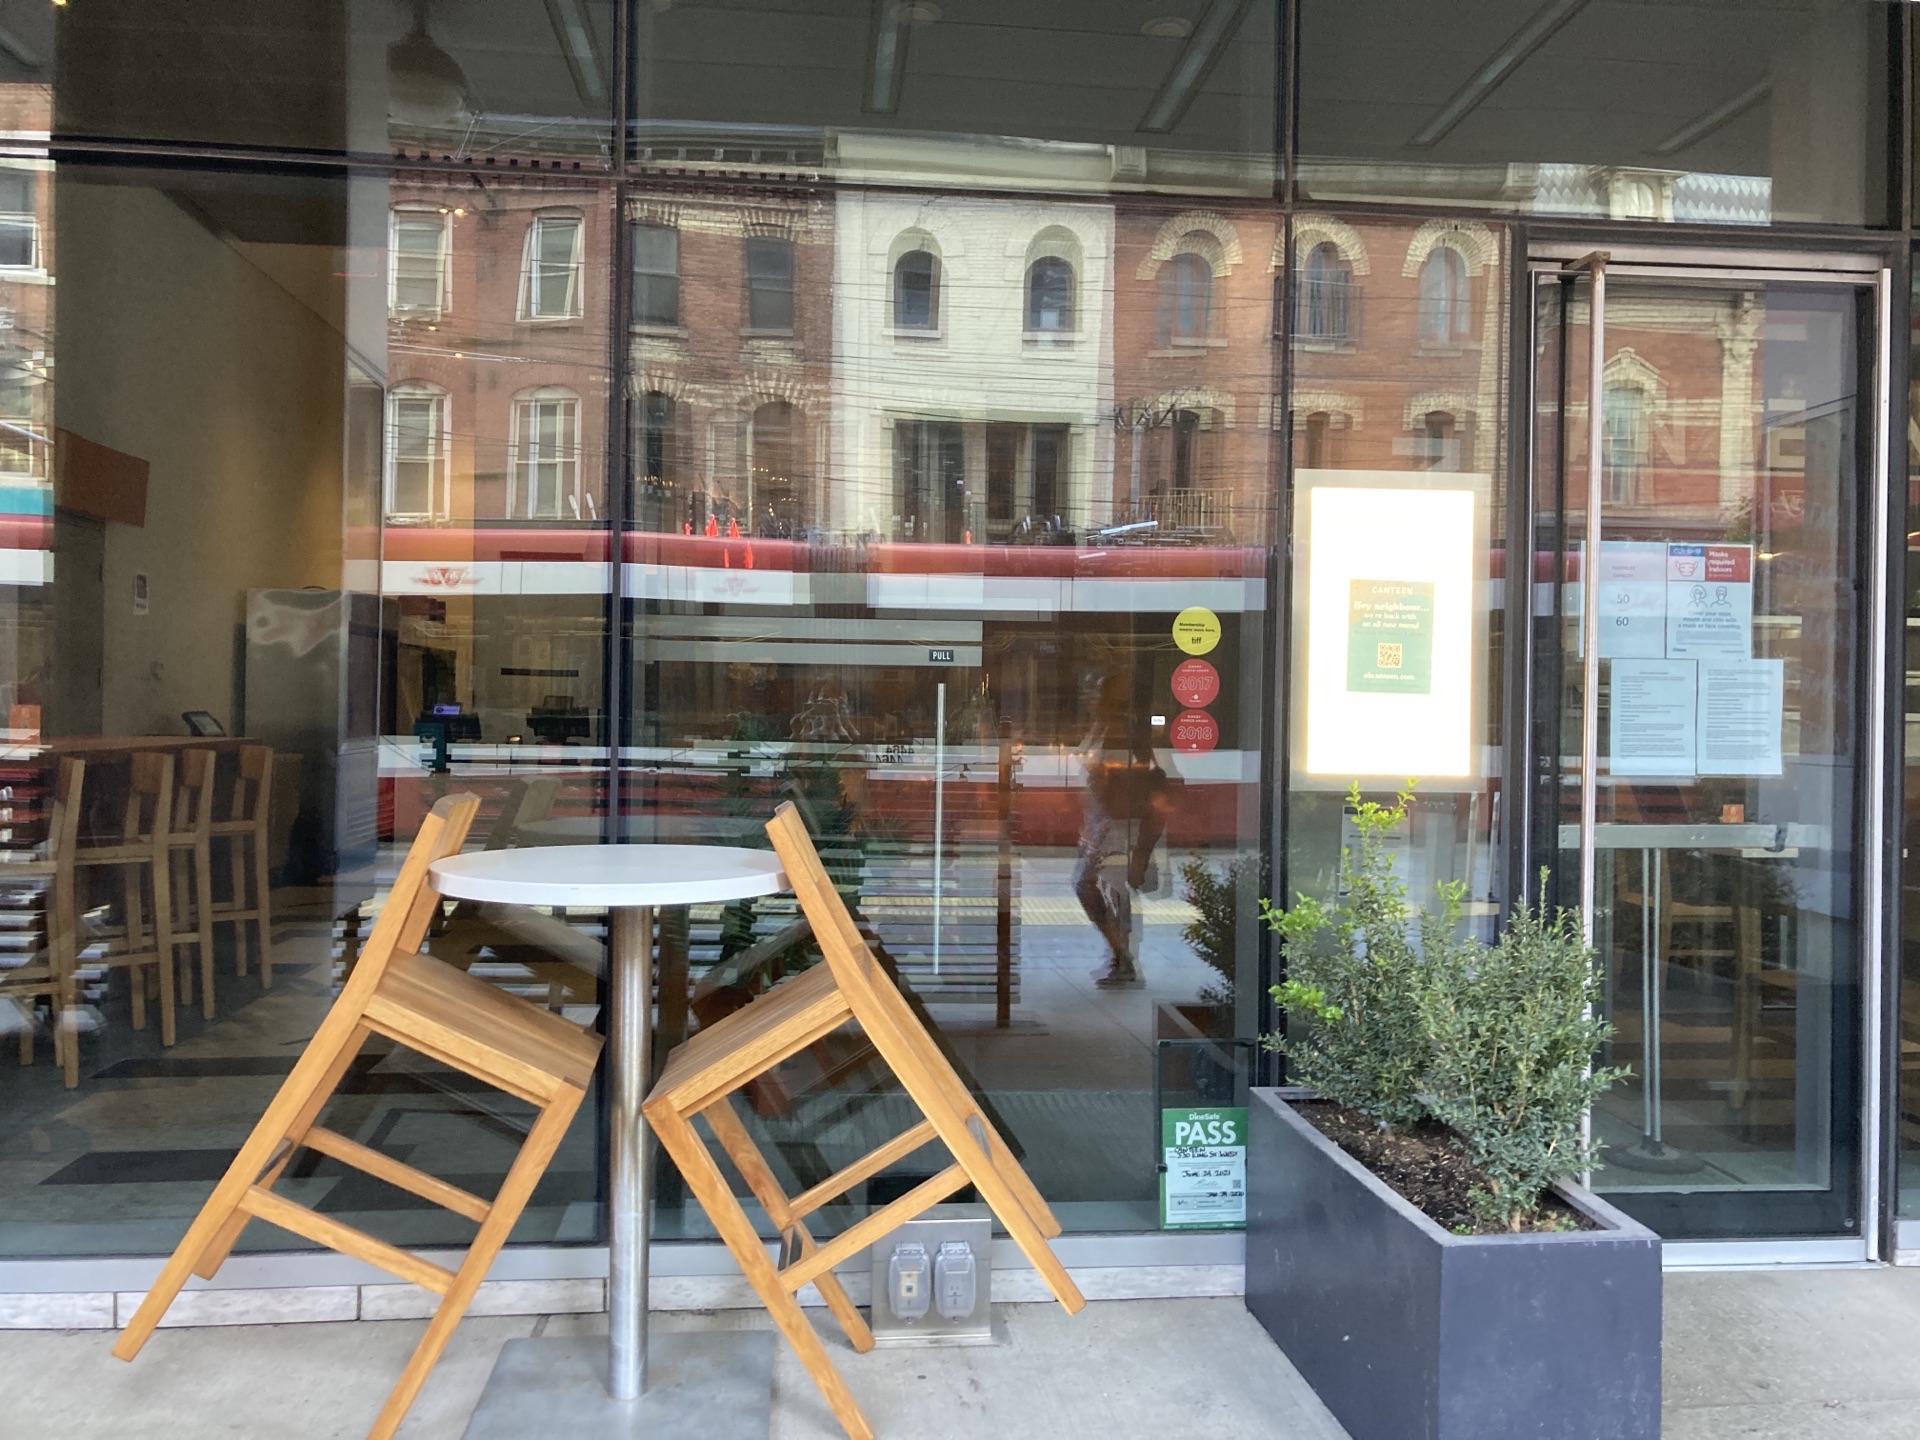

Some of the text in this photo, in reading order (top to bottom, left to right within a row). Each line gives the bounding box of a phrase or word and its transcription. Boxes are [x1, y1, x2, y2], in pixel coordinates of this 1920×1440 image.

[1708, 550, 1729, 558] Masks
[1708, 559, 1736, 567] required
[1372, 586, 1413, 595] CANTEEN
[1616, 593, 1630, 604] 50
[1353, 600, 1373, 611] Hey
[1615, 616, 1630, 627] 60
[1191, 636, 1202, 645] tiff
[932, 651, 951, 660] PULL
[1178, 675, 1213, 691] 2017
[1176, 725, 1212, 740] 2018
[1188, 1112, 1221, 1120] DineSafe
[1175, 1120, 1237, 1146] PASS
